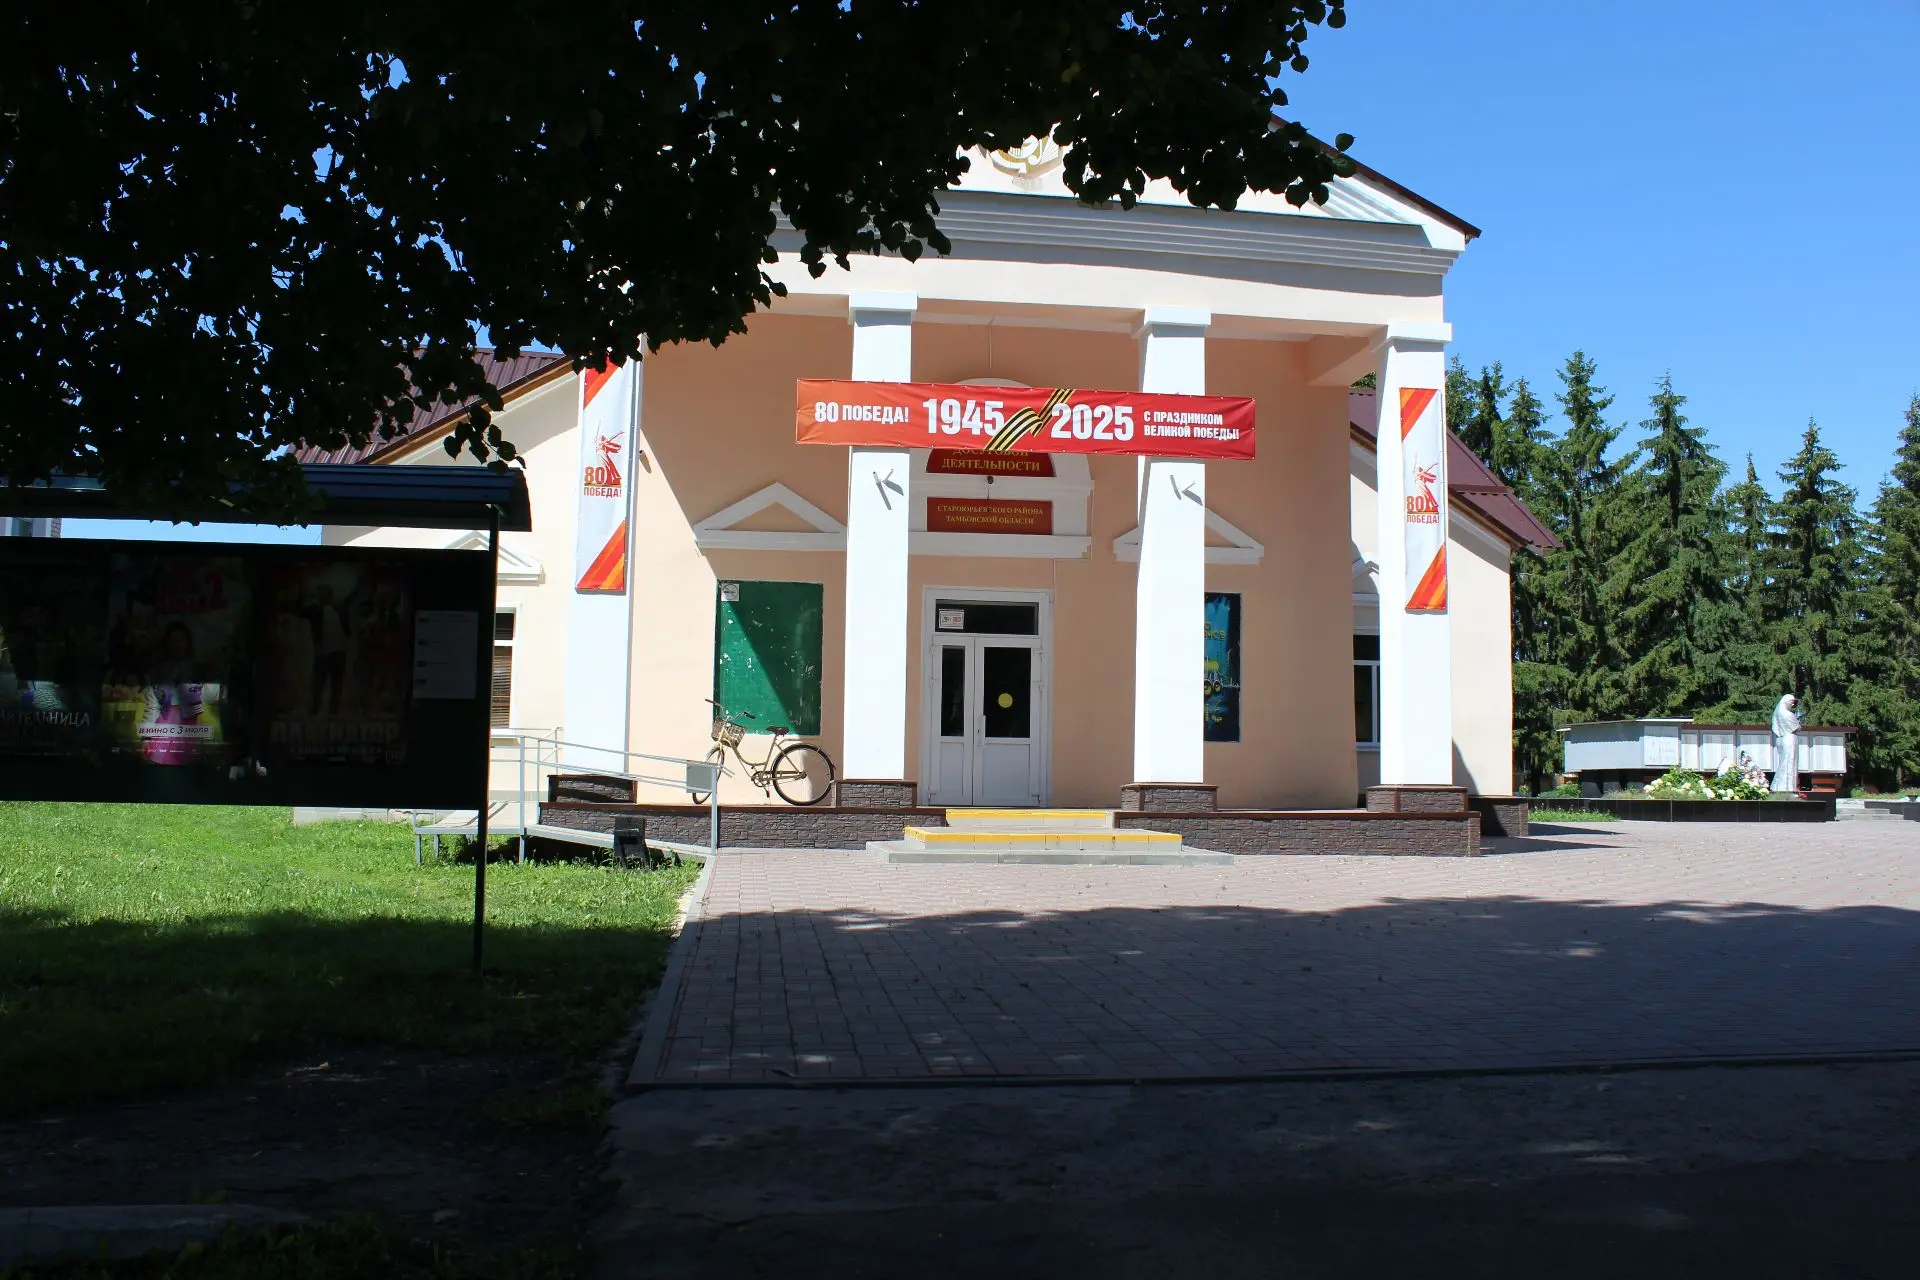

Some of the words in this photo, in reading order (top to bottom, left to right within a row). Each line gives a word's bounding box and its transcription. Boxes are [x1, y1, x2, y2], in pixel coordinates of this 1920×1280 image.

[814, 401, 839, 423] 80
[842, 404, 910, 425] ПОБЕДА!
[922, 398, 1005, 436] 1945
[1143, 411, 1151, 422] С
[1153, 411, 1224, 425] ПРАЗДНИКОМ
[1051, 402, 1134, 441] 2025
[1143, 424, 1191, 438] ВЕЛИКОЙ
[1193, 426, 1240, 441] ПОБЕДЫ!
[941, 458, 1040, 472] ДЕЯТЕЛЬНОСТИ
[584, 466, 605, 484] 80
[584, 487, 622, 498] ПОБЕДА!
[1406, 495, 1425, 512] 80
[1013, 507, 1043, 515] РАЙОНА
[946, 515, 997, 524] ТАМБОВСКОЙ
[998, 517, 1034, 525] ОБЛАСТИ
[1406, 514, 1440, 524] ПОБЕДА!
[176, 725, 183, 734] 3
